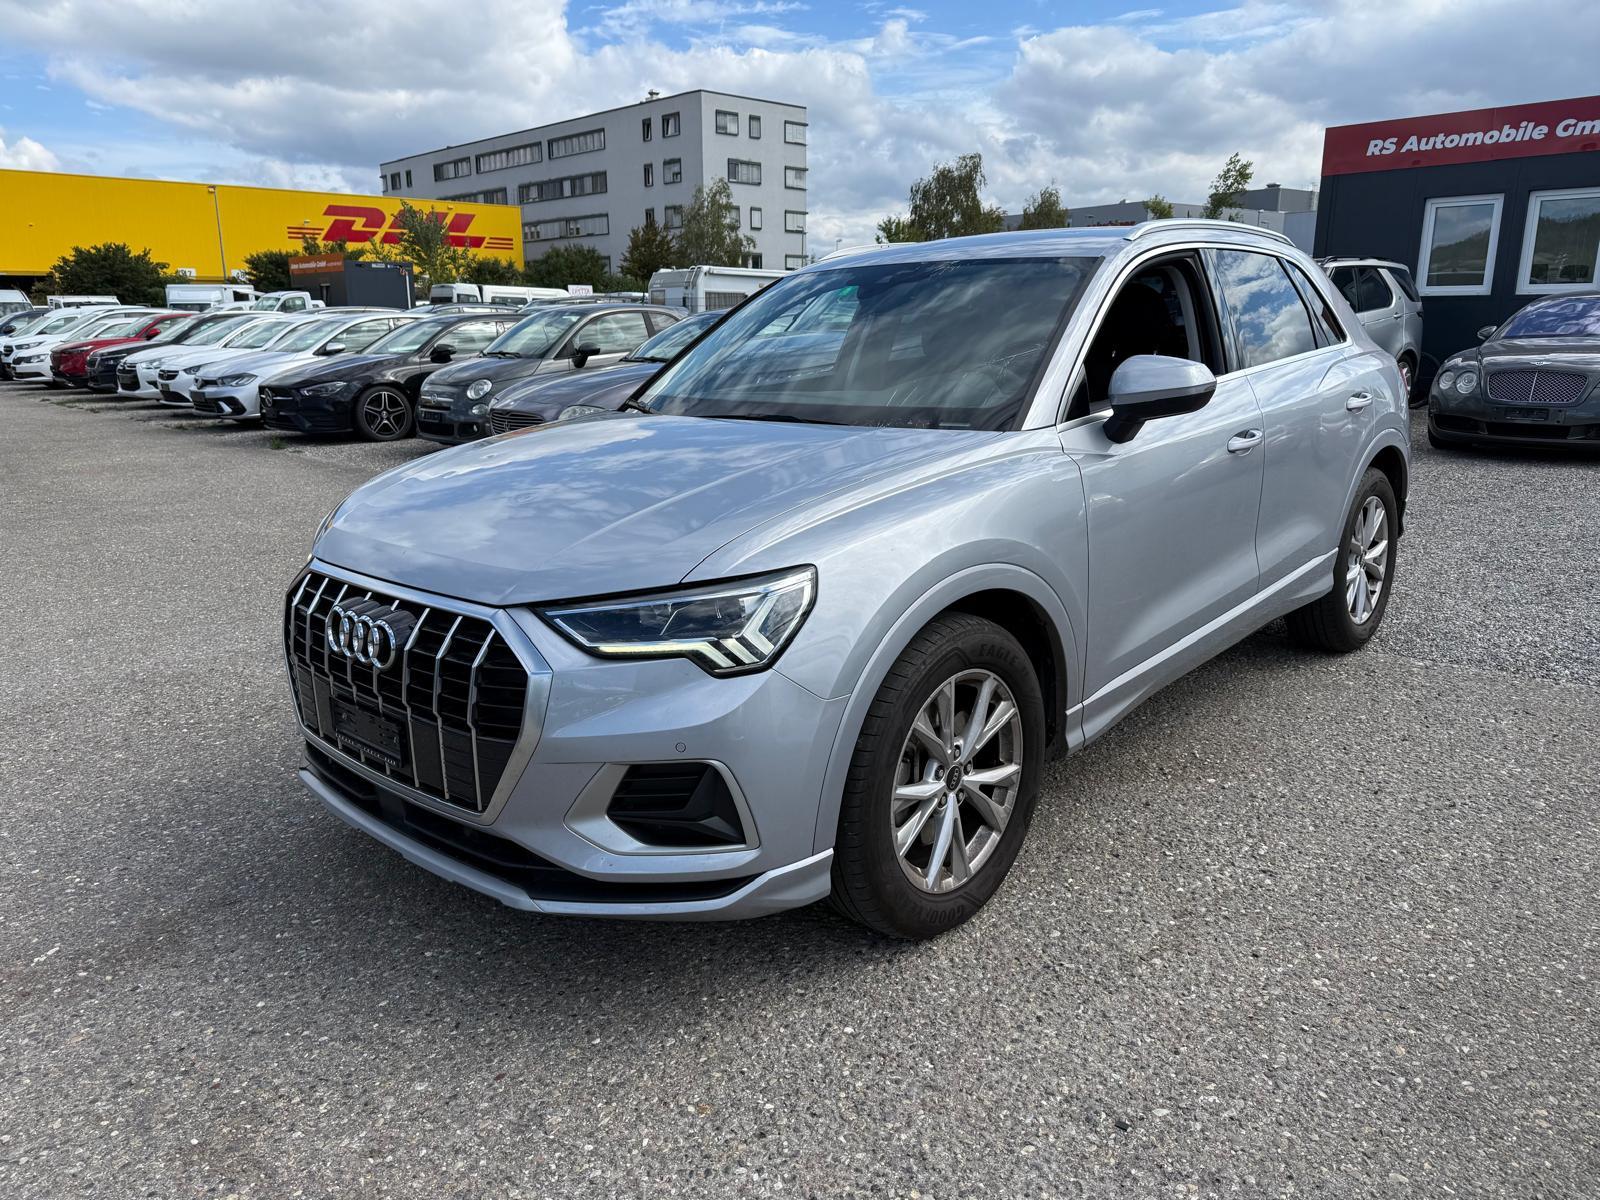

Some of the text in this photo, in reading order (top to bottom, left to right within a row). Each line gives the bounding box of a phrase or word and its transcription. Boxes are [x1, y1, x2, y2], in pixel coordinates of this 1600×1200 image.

[1366, 137, 1398, 157] RS
[1400, 120, 1549, 153] Automobile
[322, 204, 486, 249] DHL
[978, 643, 1019, 667] EAGLE
